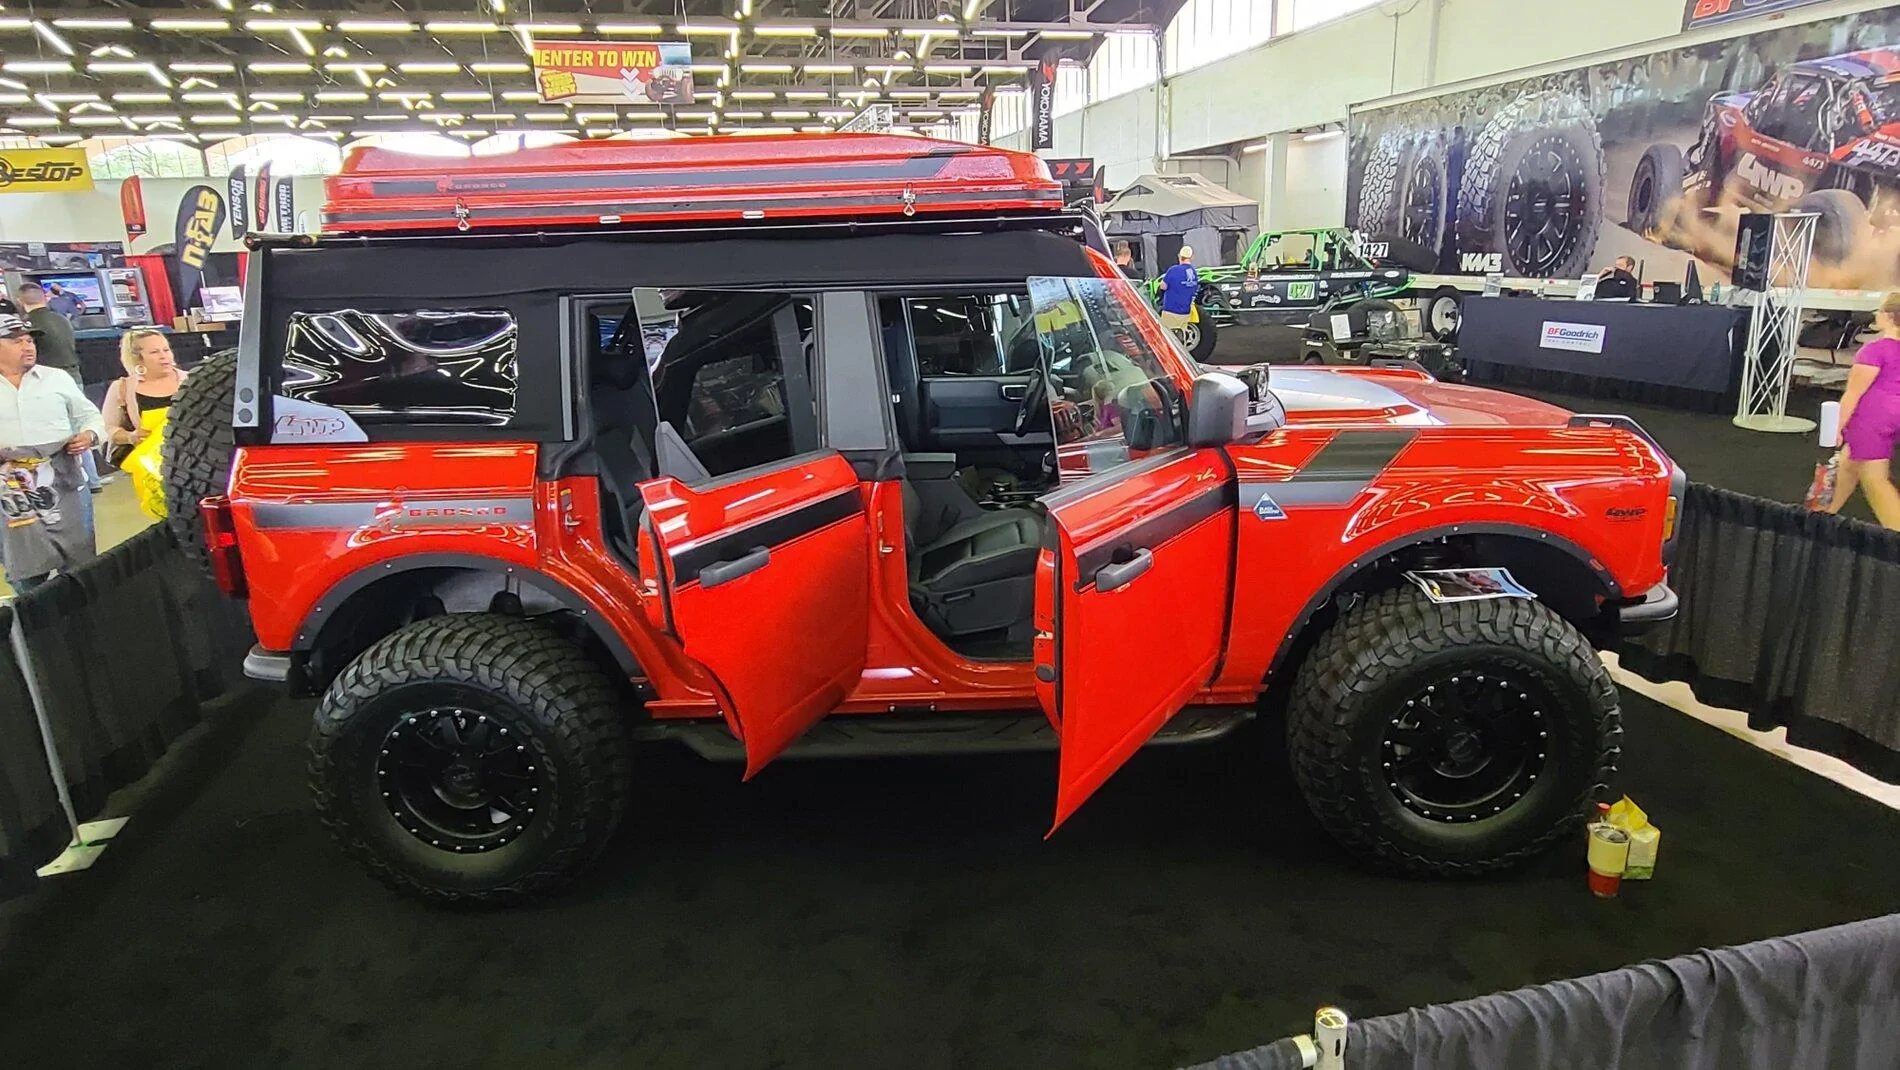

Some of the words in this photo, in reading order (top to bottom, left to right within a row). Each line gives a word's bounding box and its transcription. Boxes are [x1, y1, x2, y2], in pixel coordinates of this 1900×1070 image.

[597, 50, 618, 67] TO
[622, 50, 657, 68] WIN
[1038, 82, 1052, 145] YOKOHAMA
[230, 178, 244, 227] TENSOR
[1359, 243, 1388, 257] 1427
[1461, 252, 1503, 271] KM3
